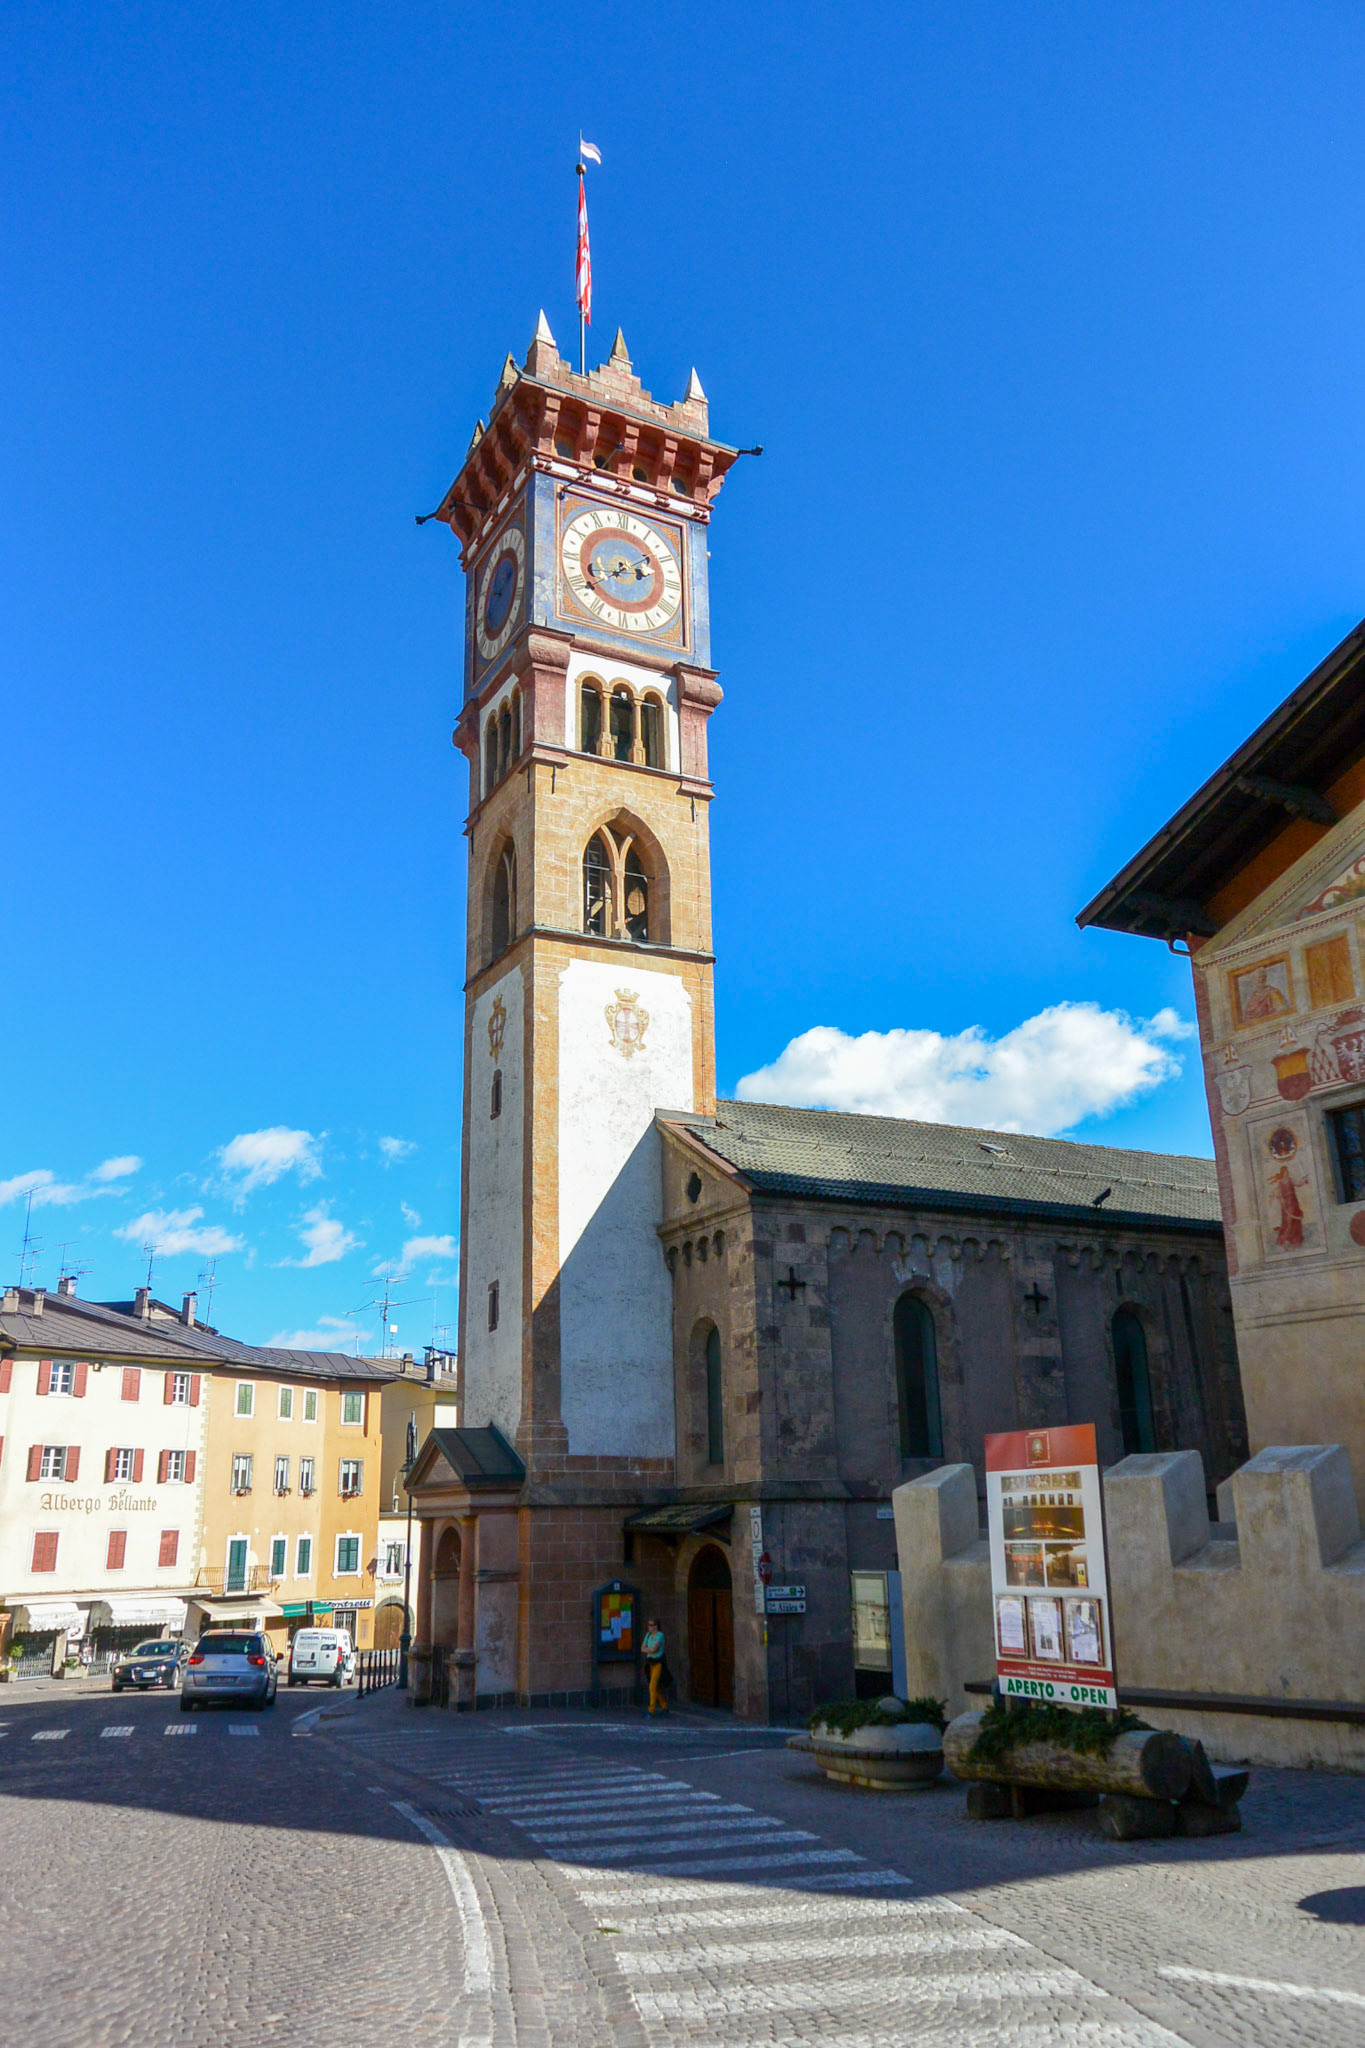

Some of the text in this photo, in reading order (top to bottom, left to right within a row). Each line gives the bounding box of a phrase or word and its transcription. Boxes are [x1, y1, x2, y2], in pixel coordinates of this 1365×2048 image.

[617, 513, 629, 530] XII
[569, 525, 586, 541] X
[40, 1493, 157, 1515] Albergo Bellante
[1007, 1678, 1055, 1698] APERTO
[1070, 1686, 1108, 1705] OPEN
